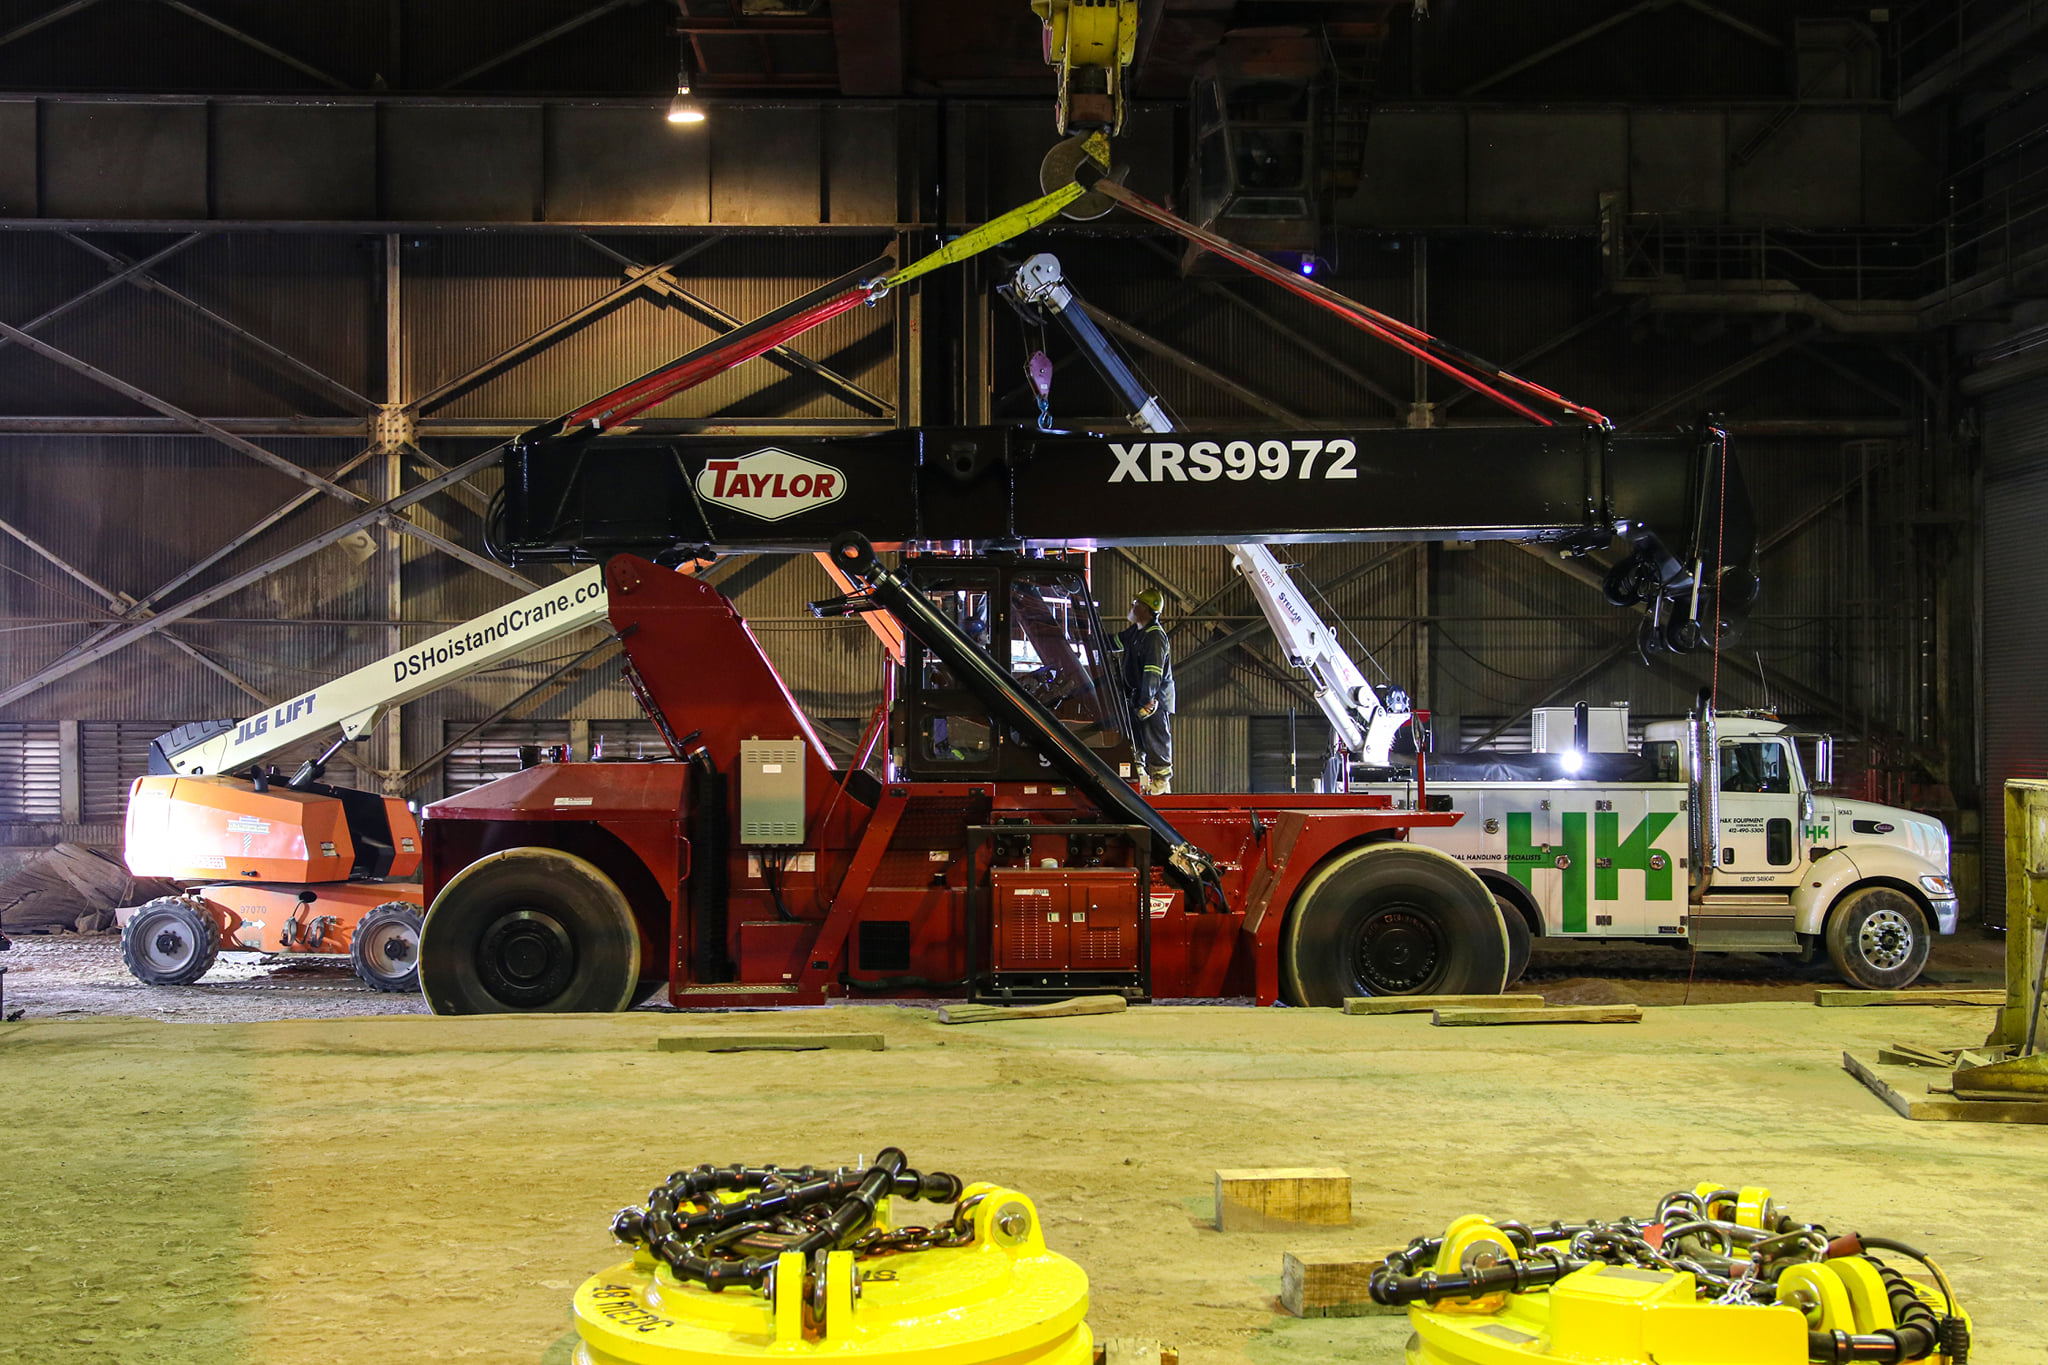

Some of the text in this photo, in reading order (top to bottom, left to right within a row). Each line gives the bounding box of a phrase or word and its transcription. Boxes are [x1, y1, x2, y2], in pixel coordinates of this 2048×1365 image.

[1107, 439, 1358, 482] XRS9972
[708, 461, 836, 498] TAYLOR
[1278, 592, 1302, 623] STELLAR
[234, 693, 317, 746] JLG LIFT
[1805, 825, 1829, 844] HK
[240, 905, 267, 914] 97070
